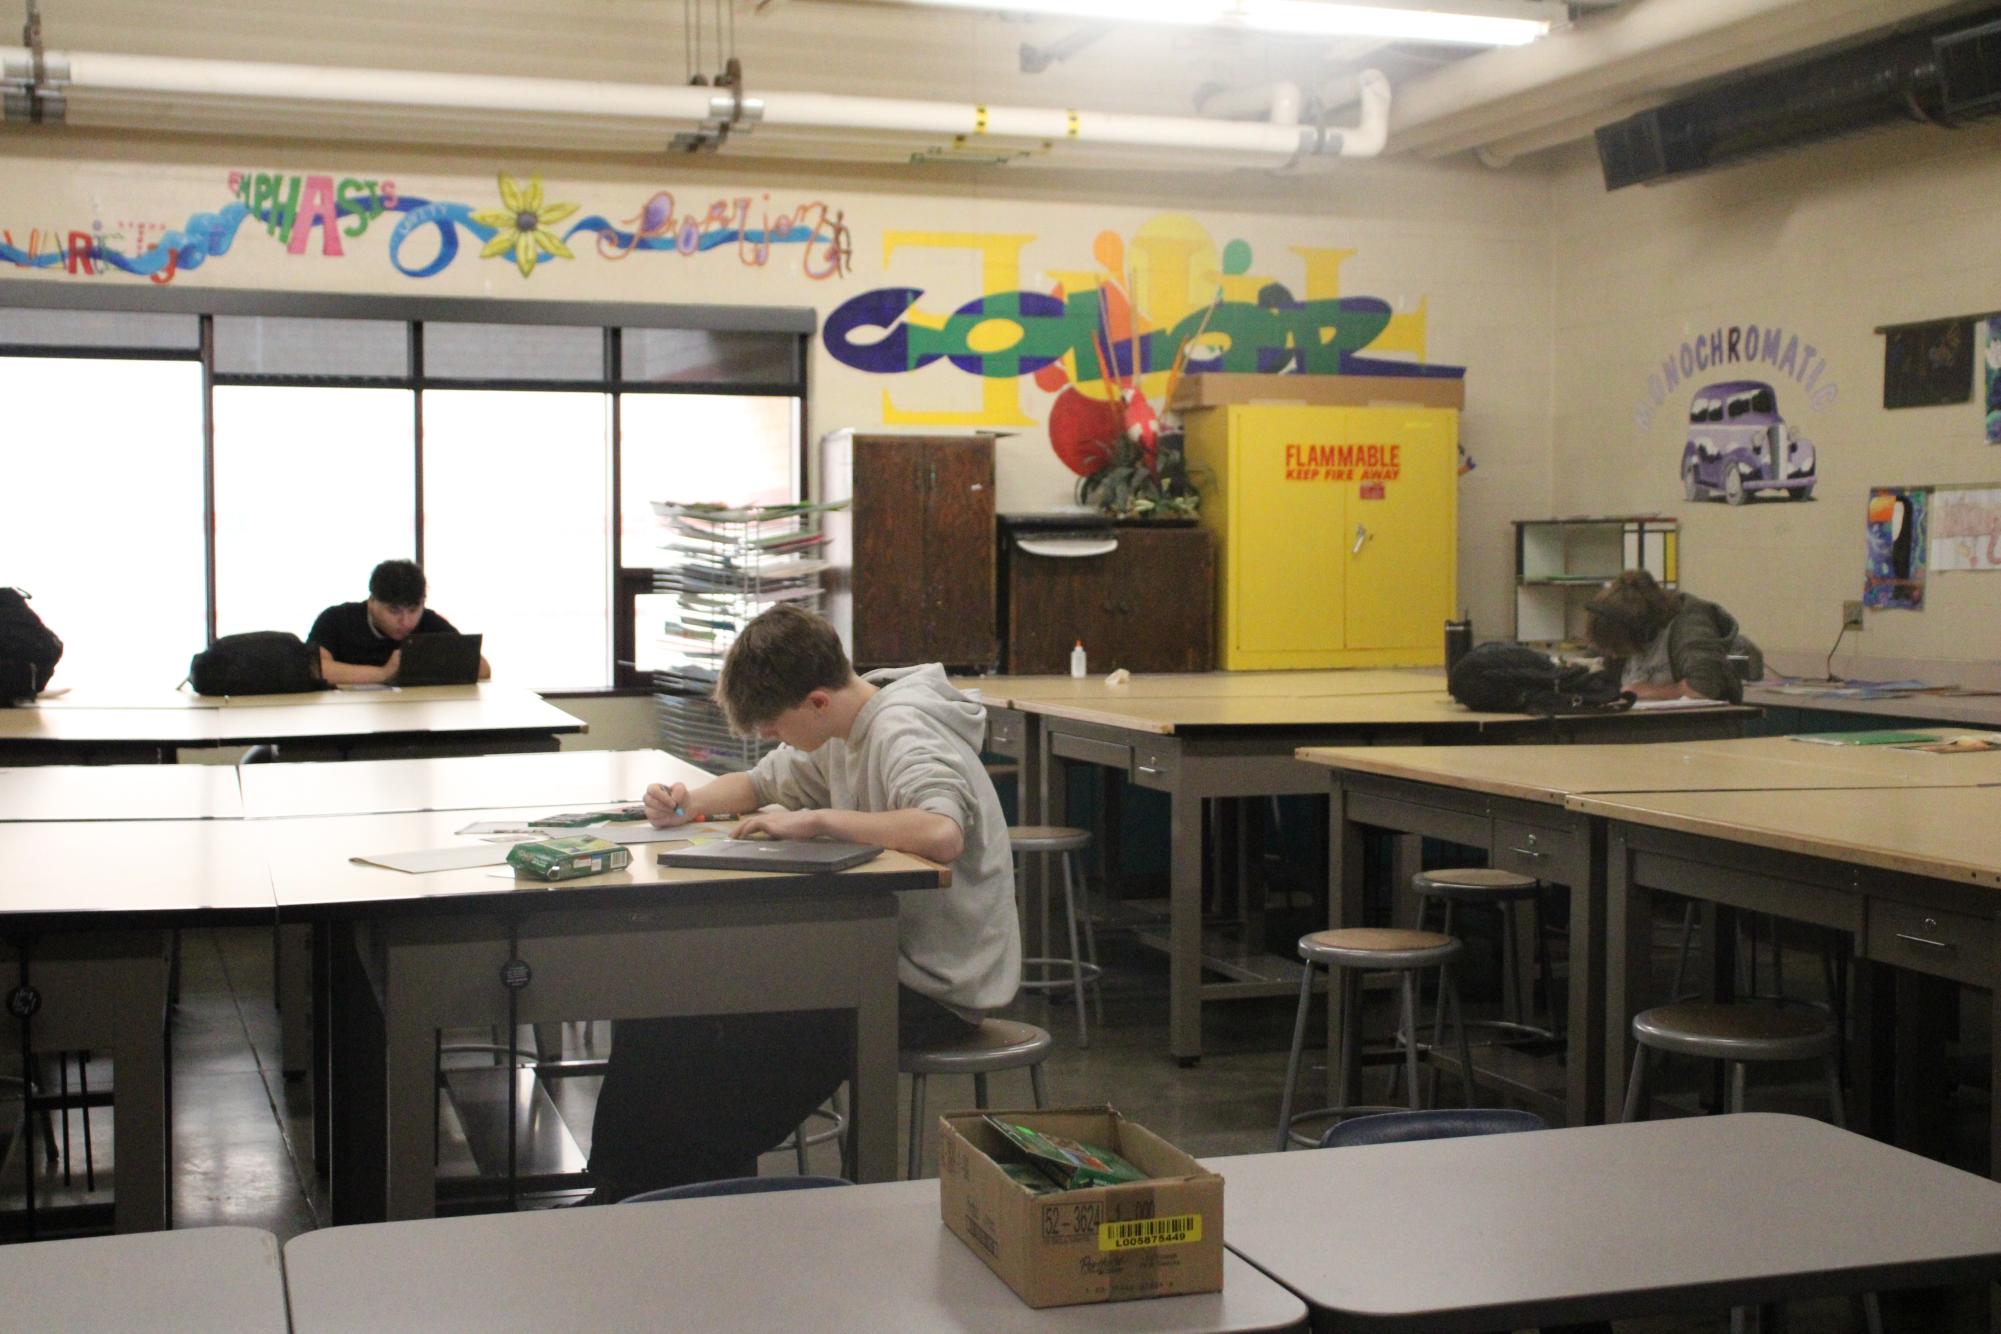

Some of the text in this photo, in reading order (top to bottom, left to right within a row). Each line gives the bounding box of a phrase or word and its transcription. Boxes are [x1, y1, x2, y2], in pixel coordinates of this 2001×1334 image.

[1634, 324, 1838, 433] MONOCHROMATIC
[1286, 444, 1401, 468] FLAMMABLE
[1286, 468, 1400, 480] KEEP FIRE AWAY
